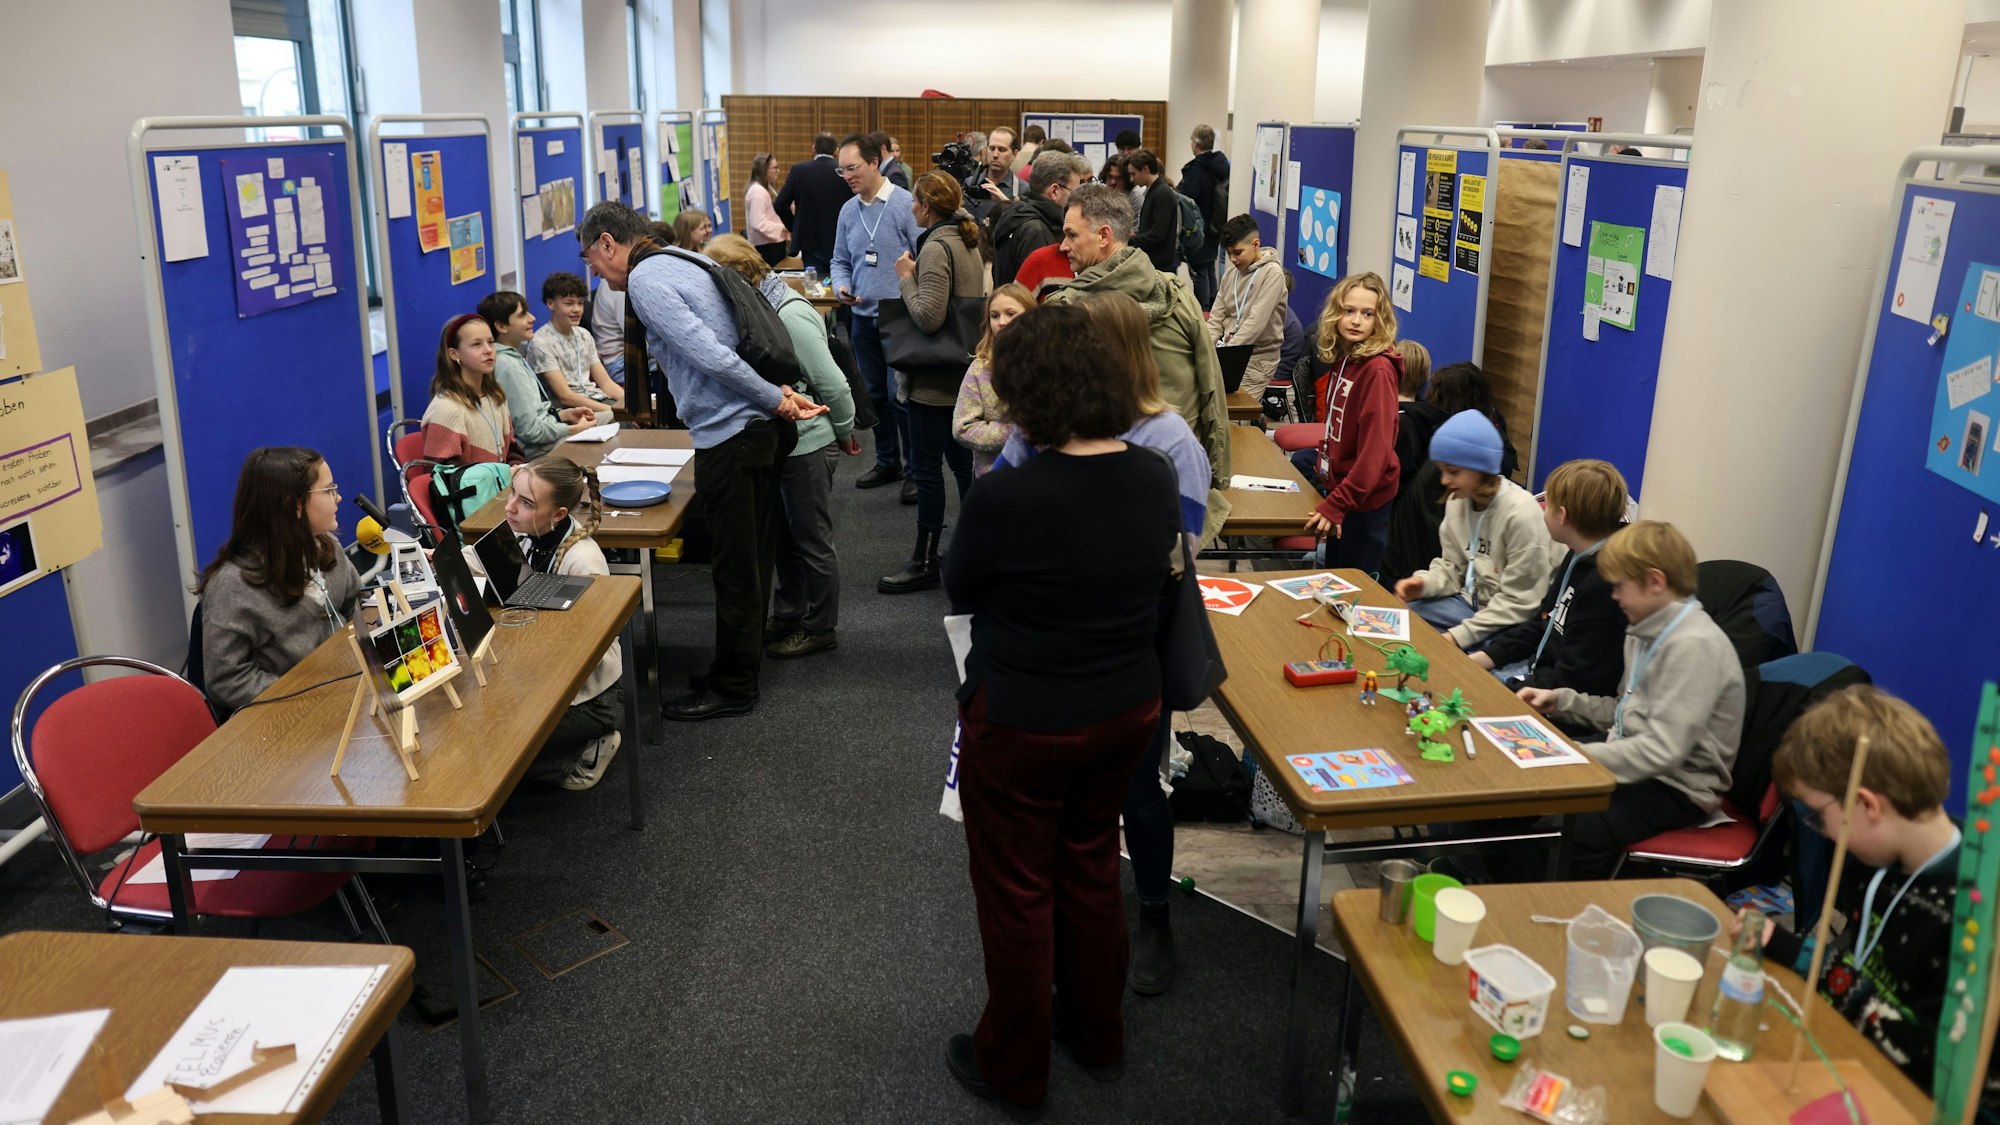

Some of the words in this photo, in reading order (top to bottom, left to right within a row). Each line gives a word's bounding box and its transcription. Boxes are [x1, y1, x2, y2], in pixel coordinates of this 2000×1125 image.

[2, 457, 25, 472] ersten
[28, 448, 52, 462] Proben
[18, 469, 36, 480] nichts
[39, 462, 57, 473] sehen
[37, 480, 62, 494] sichtbar
